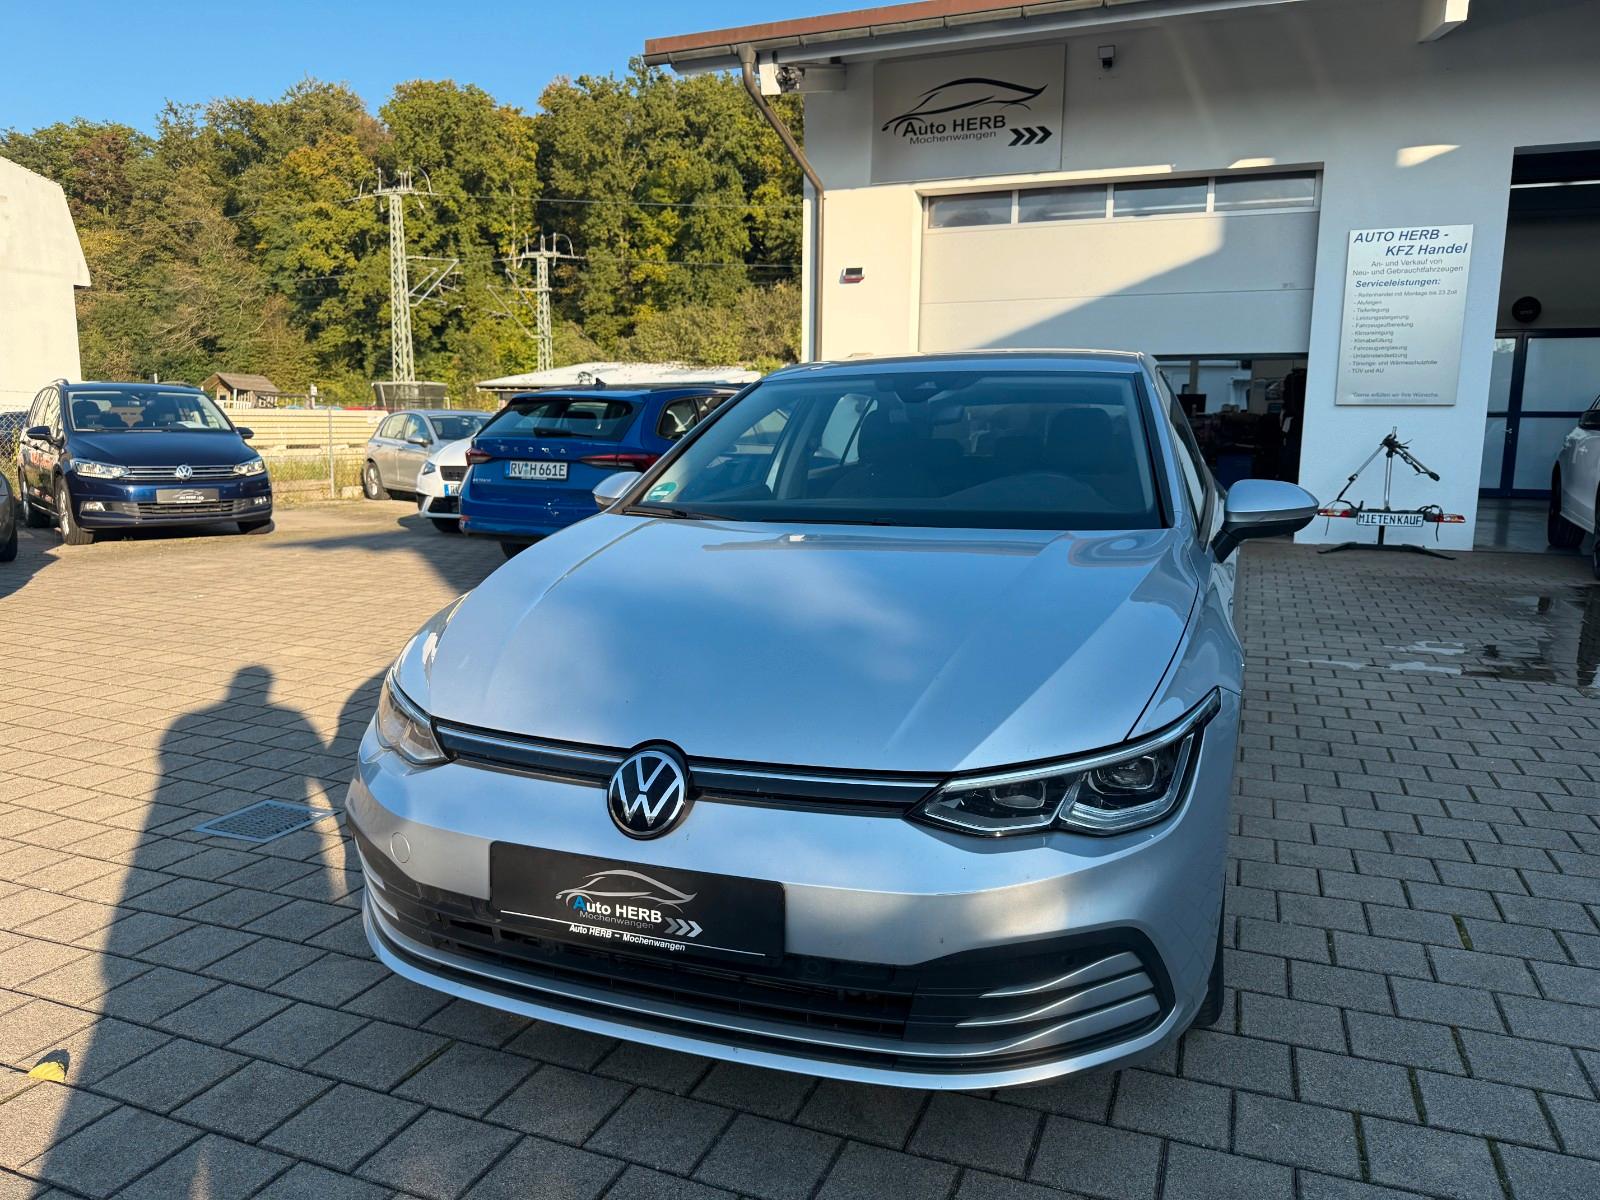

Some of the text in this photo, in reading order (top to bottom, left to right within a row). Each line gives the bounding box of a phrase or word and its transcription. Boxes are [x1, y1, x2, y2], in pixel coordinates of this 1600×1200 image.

[902, 115, 1006, 137] Auto HERB
[909, 130, 996, 145] Mochenwangen
[1353, 231, 1394, 243] AUTO
[1398, 229, 1440, 241] HERB
[1385, 243, 1468, 256] KFZ Handel
[1386, 266, 1463, 275] Gebrauchtfahrzeugen
[1355, 278, 1441, 288] Serviceleistungen:
[510, 462, 566, 477] RV H 661E
[572, 895, 662, 924] Auto HERB
[579, 910, 654, 929] Mochenwangen
[569, 924, 587, 935] Auto
[589, 927, 612, 938] HERB
[623, 933, 686, 951] Mochenwangen
